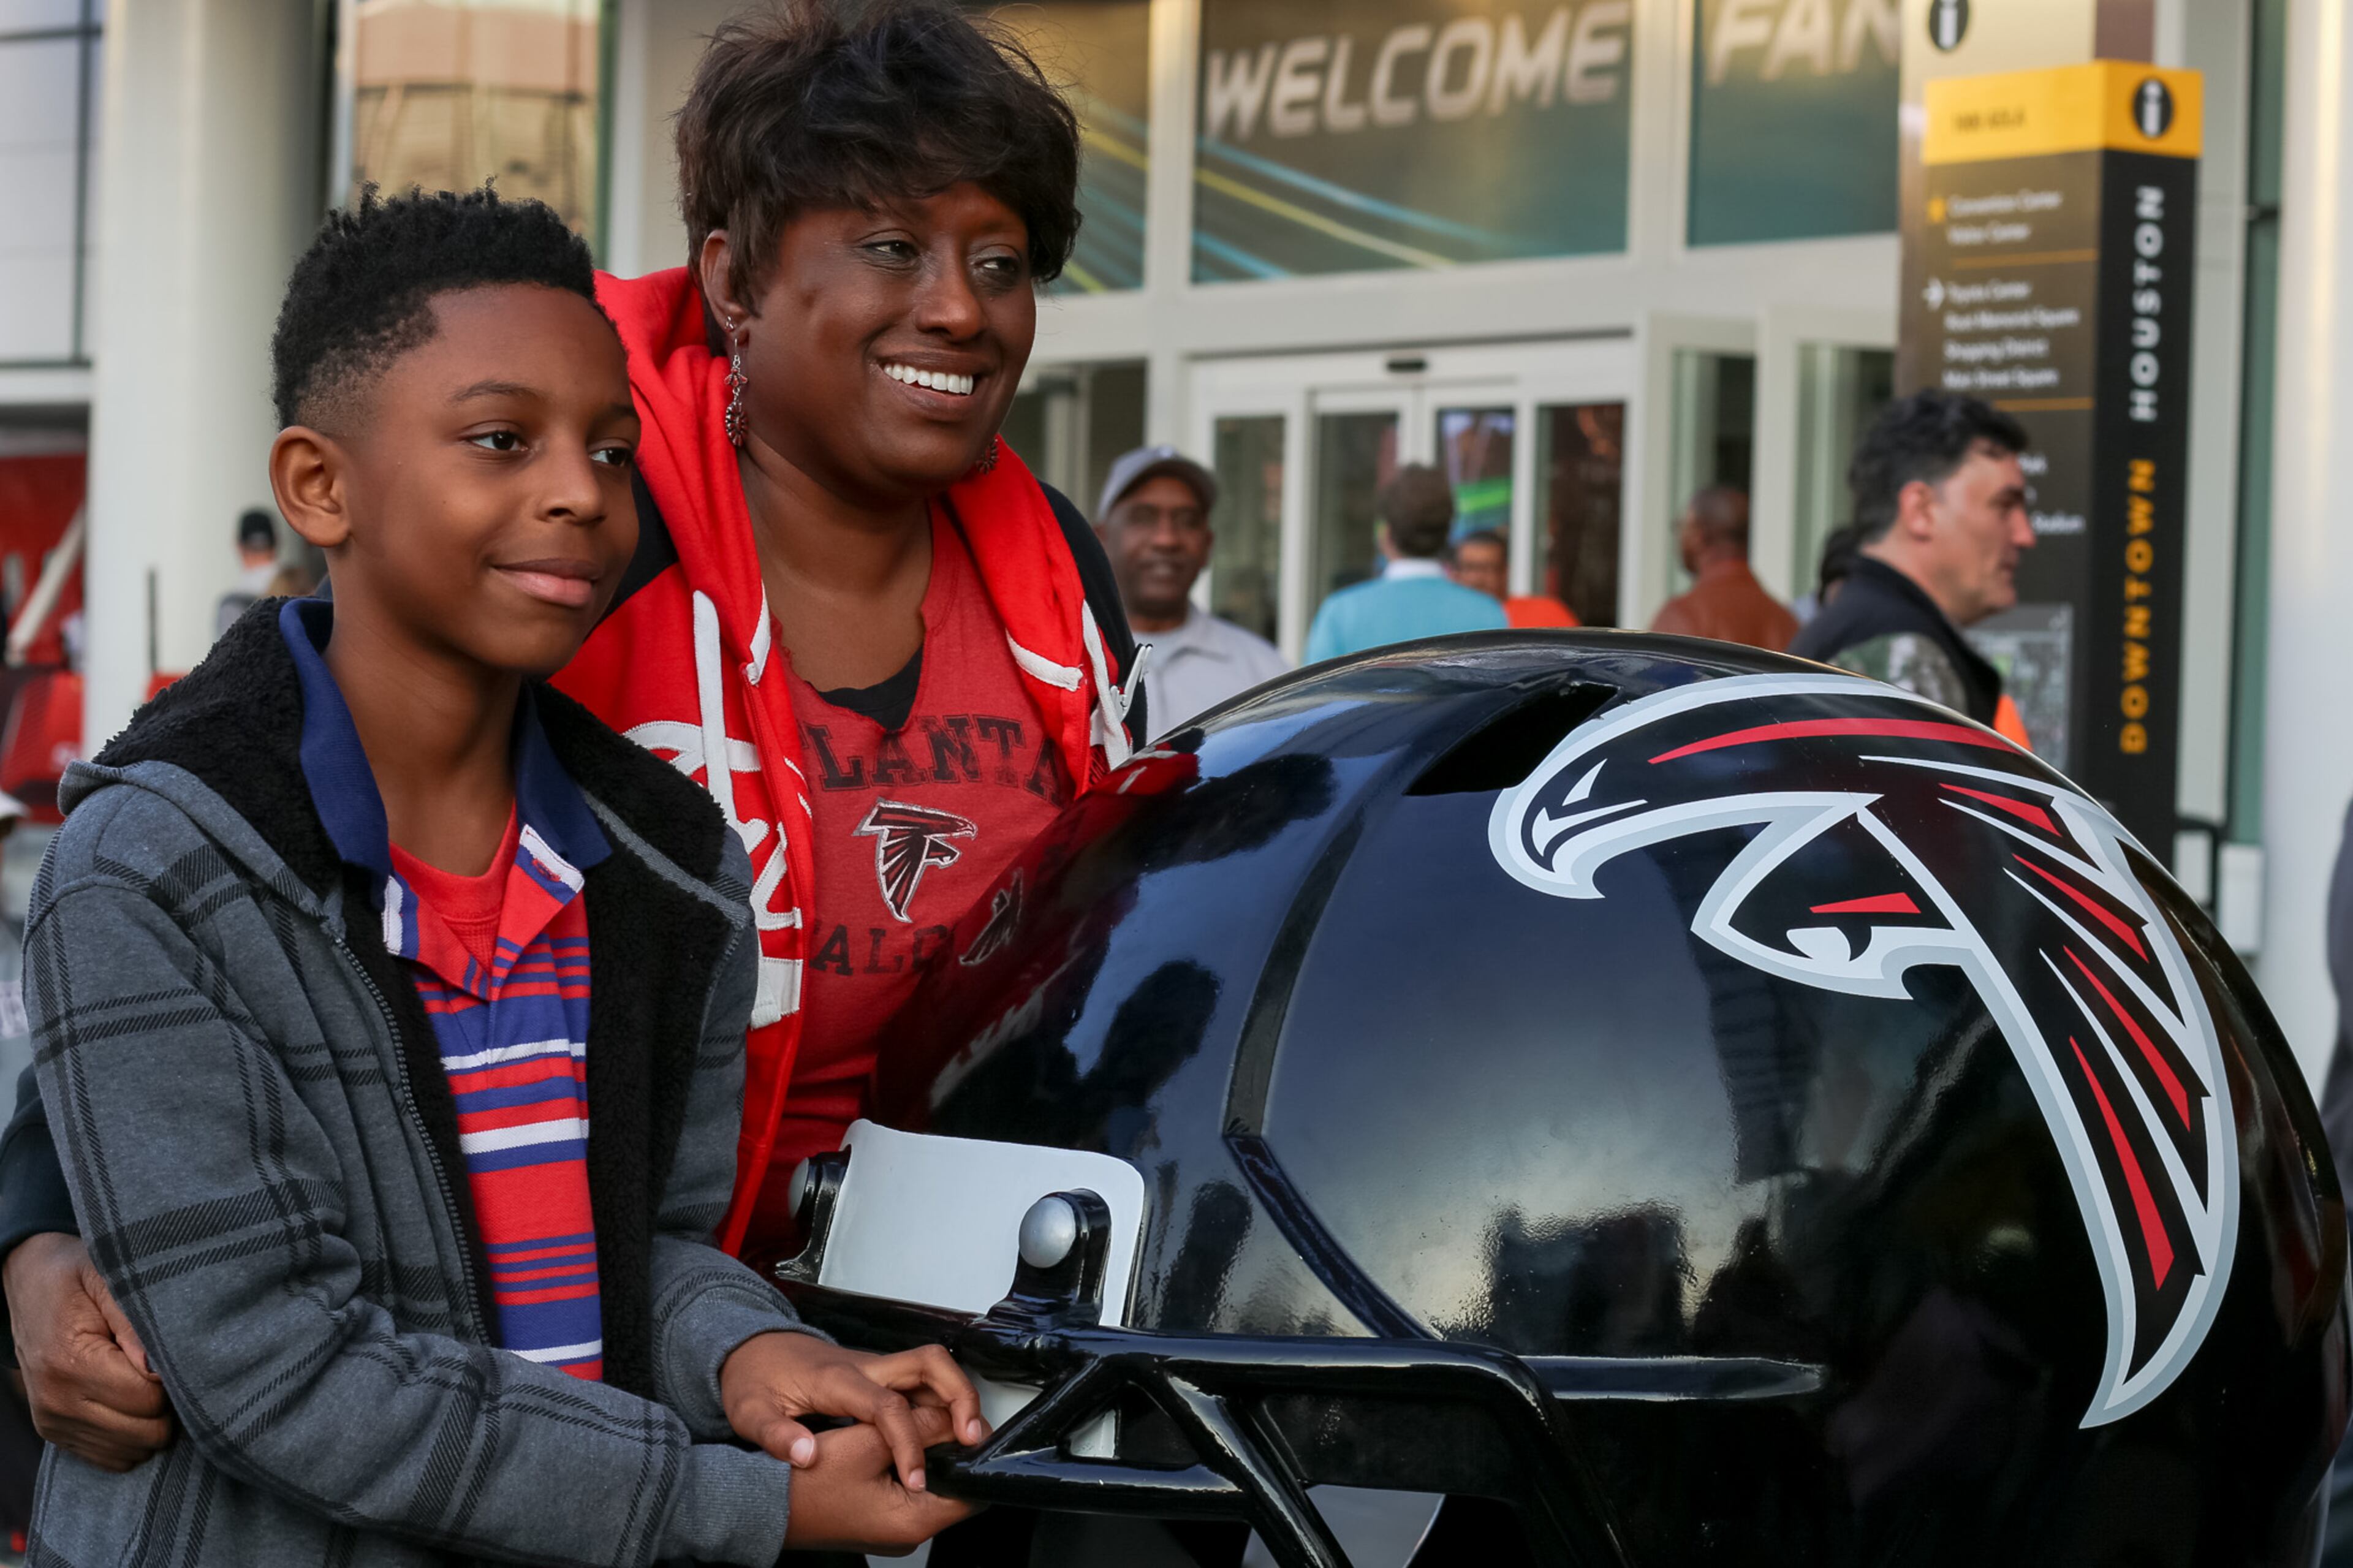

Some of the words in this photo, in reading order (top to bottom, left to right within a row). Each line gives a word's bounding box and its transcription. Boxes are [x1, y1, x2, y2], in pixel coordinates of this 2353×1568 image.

[1205, 3, 1630, 140] WELCOME
[2130, 186, 2164, 421] HOUSTON
[2120, 460, 2155, 753] DOWNTOWN
[799, 714, 1064, 808] LANTA
